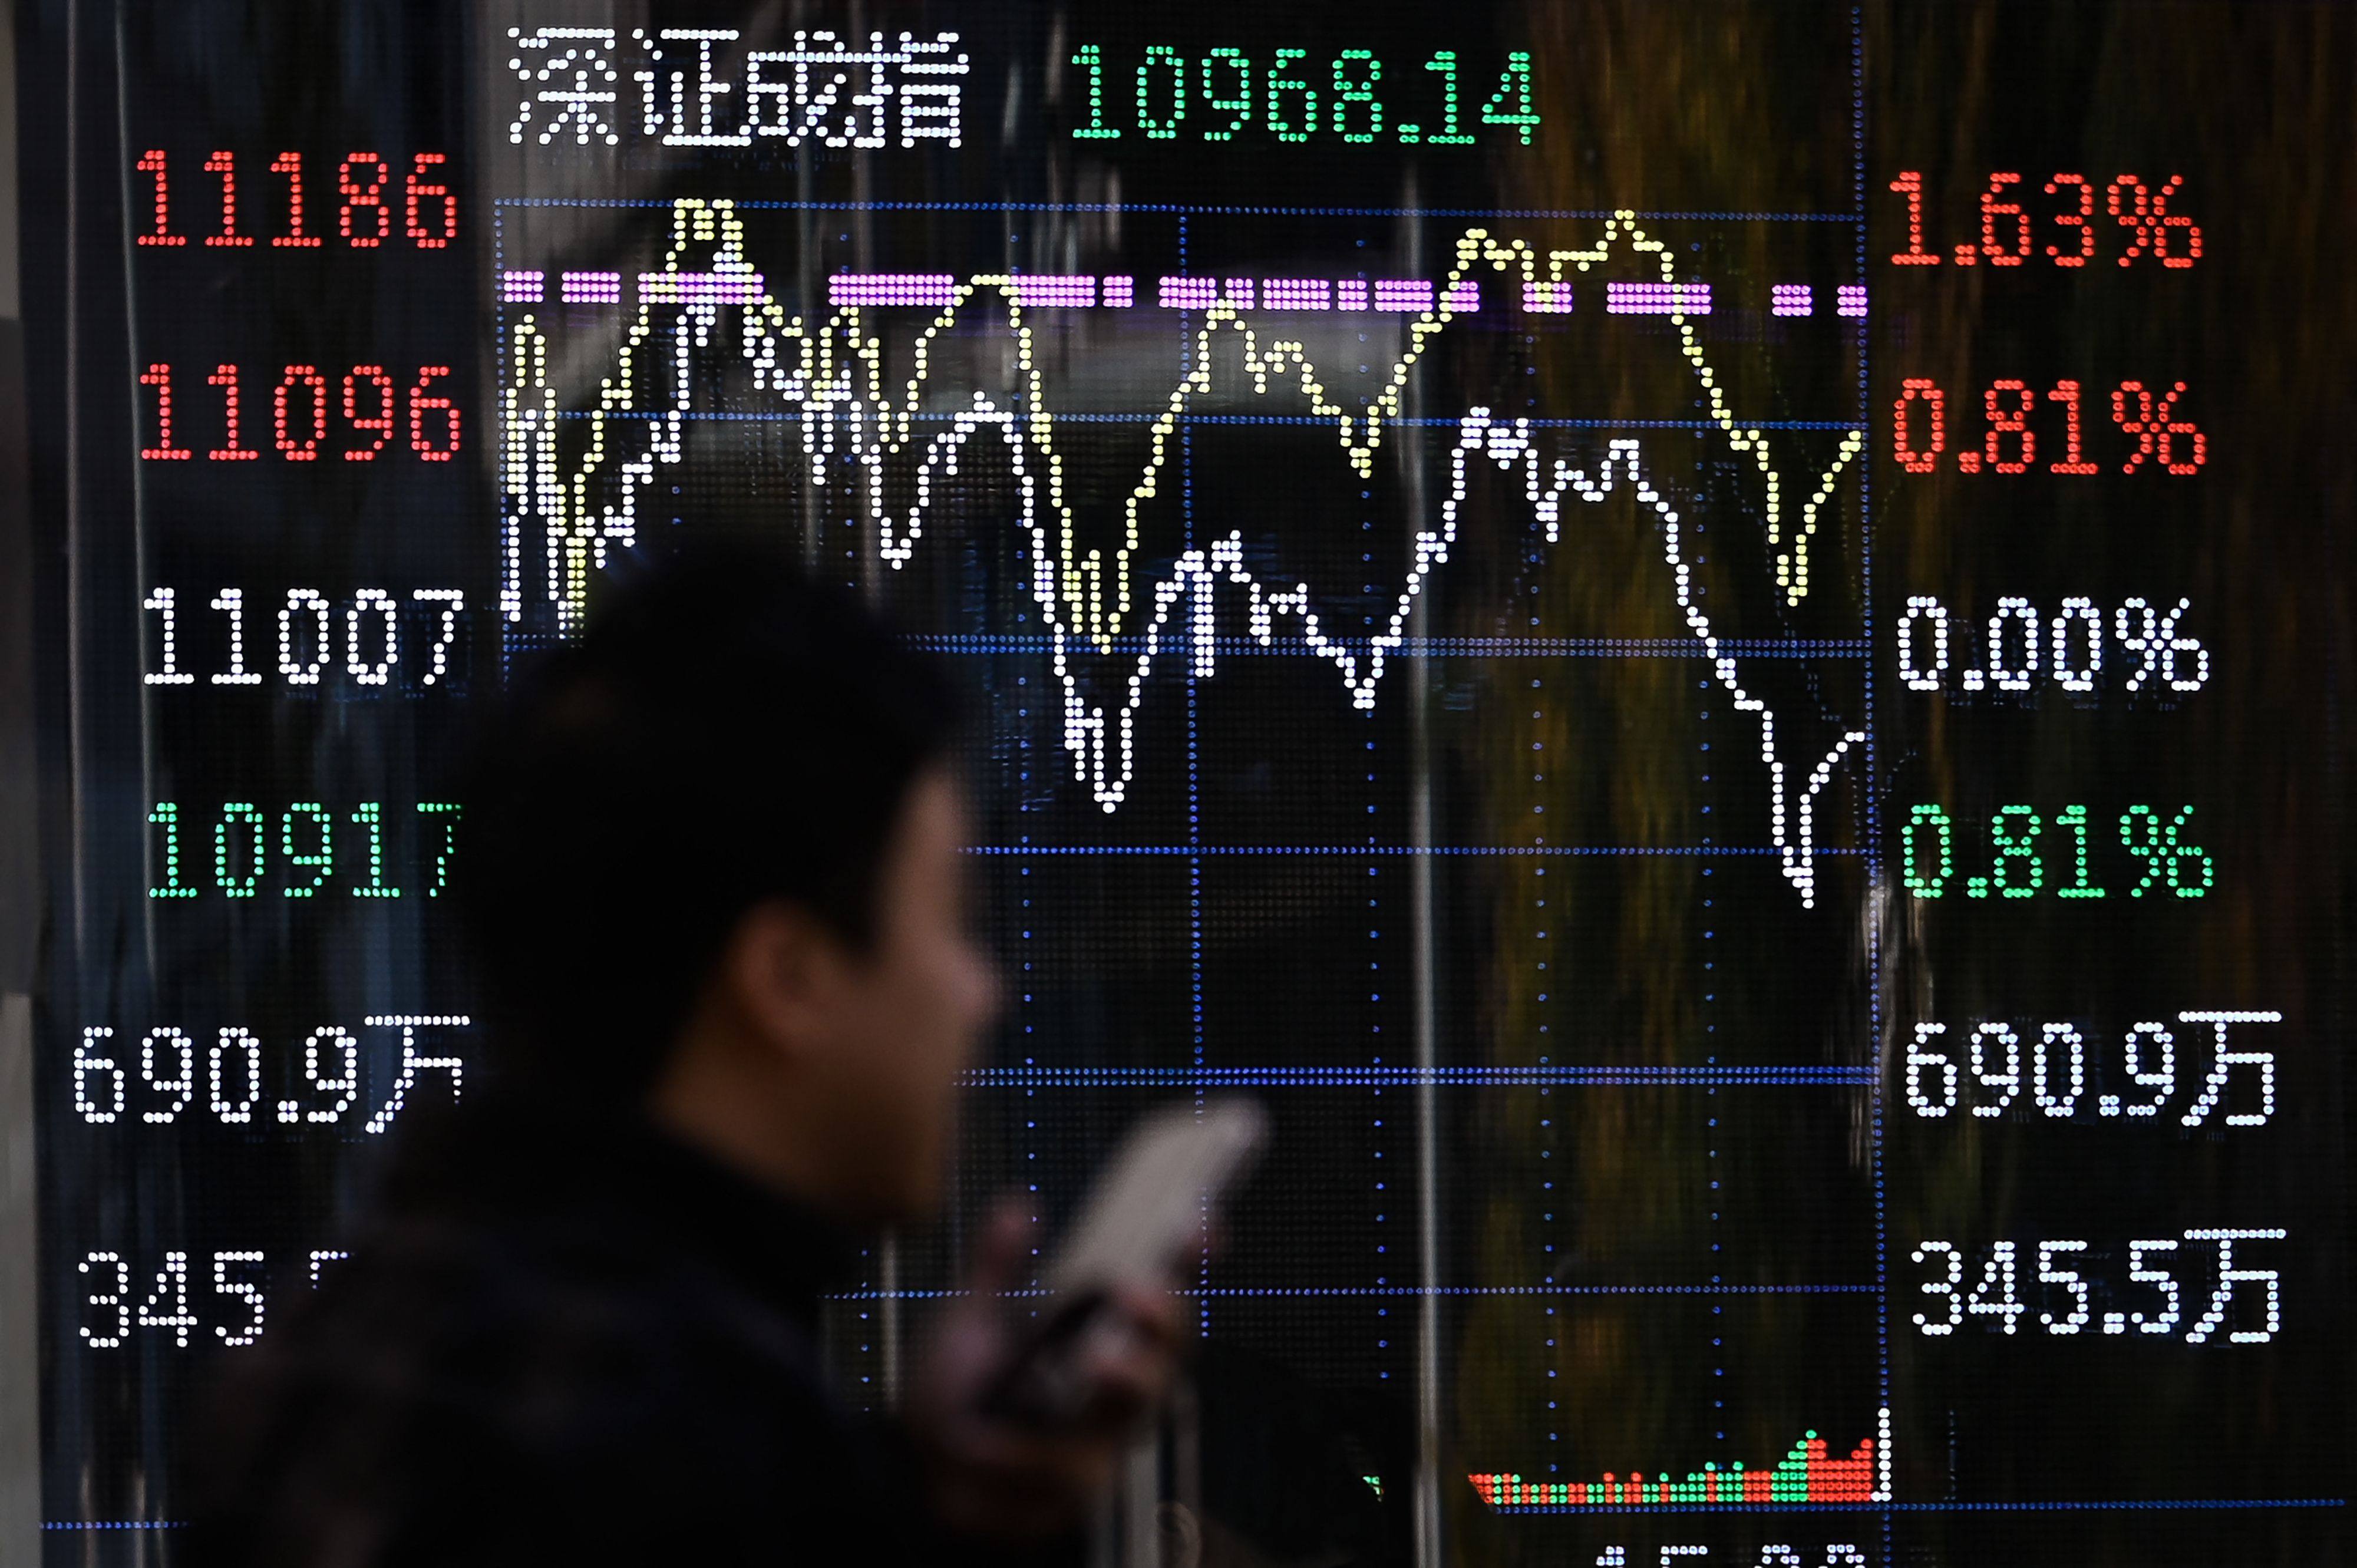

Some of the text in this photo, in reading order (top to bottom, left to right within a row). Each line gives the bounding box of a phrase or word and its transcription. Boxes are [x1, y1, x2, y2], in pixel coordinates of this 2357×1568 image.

[507, 27, 970, 148] 深证成指
[1071, 44, 1541, 145] 10968.14
[137, 149, 457, 249] 11186
[1889, 171, 2203, 268] 1.63%
[139, 363, 461, 461] 11096
[1893, 378, 2206, 476] 0.81%
[143, 587, 464, 685] 11007
[1897, 596, 2209, 692] 0.00%
[147, 802, 462, 899] 10917
[1901, 804, 2214, 899] 0.81%
[1906, 1011, 2282, 1127] 690.9万
[1911, 1228, 2287, 1343] 345.5万
